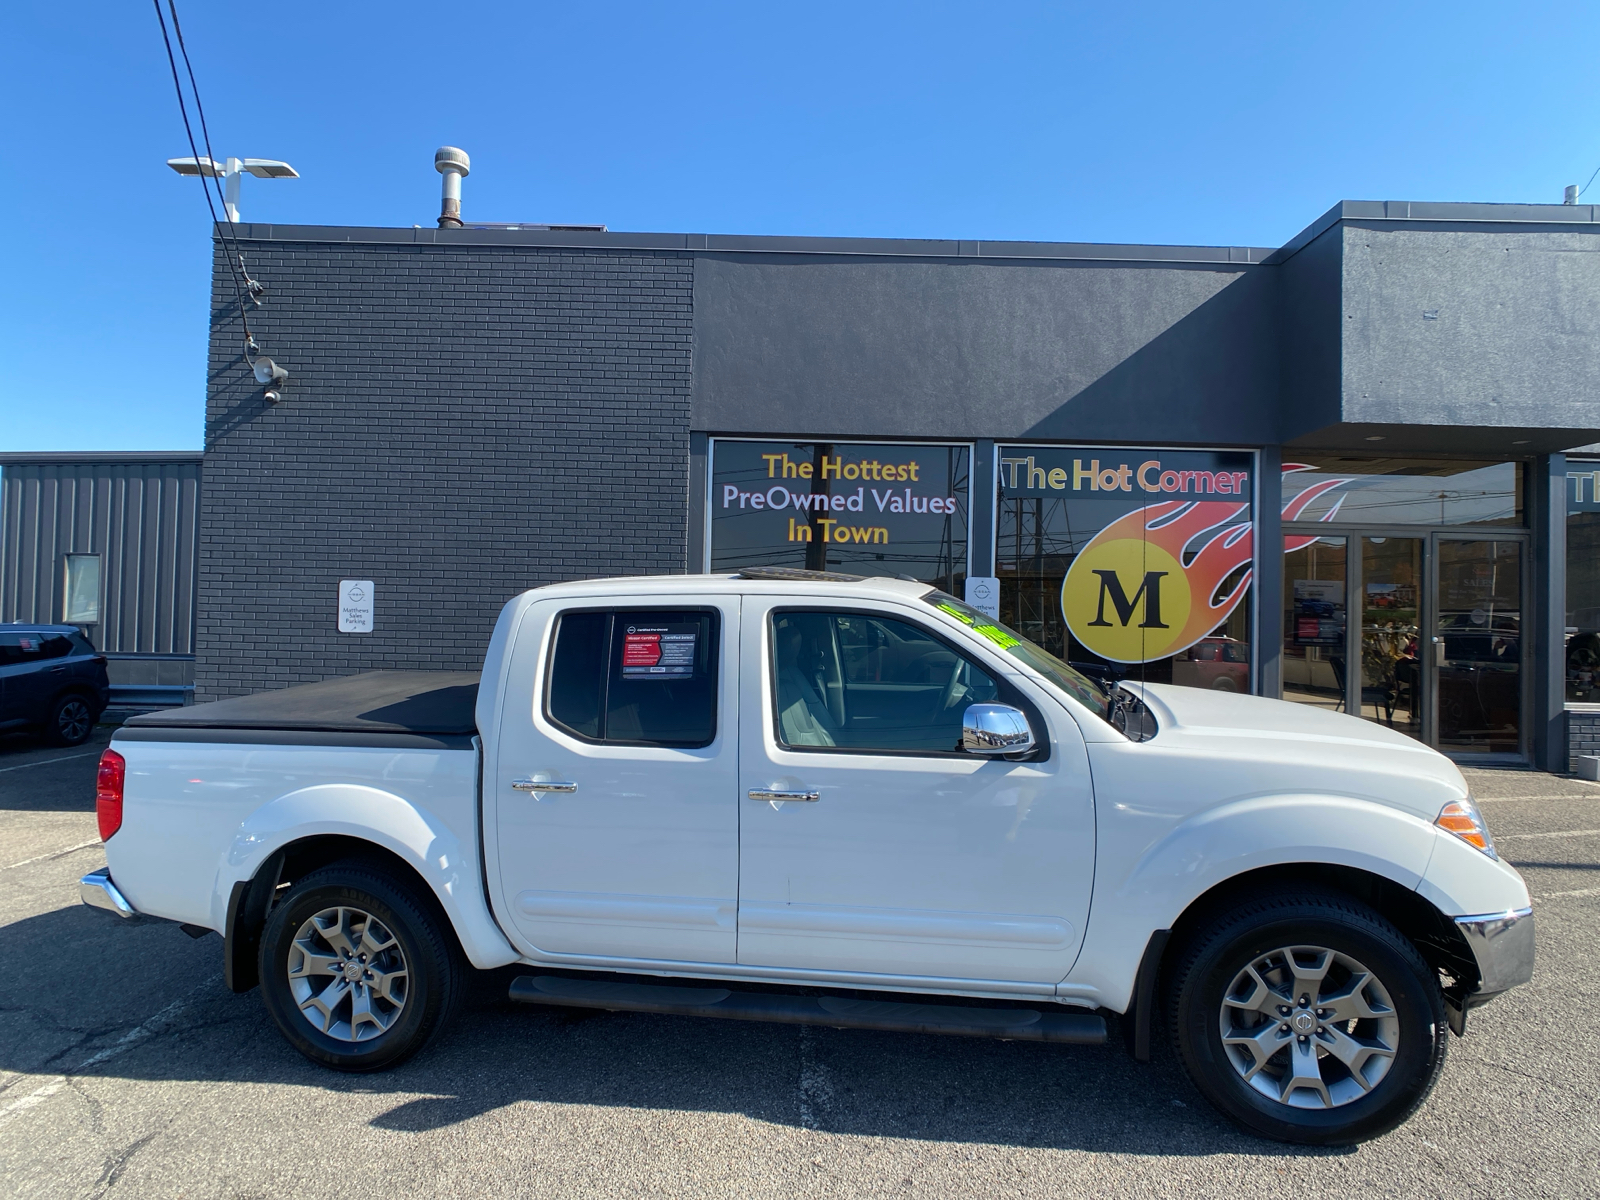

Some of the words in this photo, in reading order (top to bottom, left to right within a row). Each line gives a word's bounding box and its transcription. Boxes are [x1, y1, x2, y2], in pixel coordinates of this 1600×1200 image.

[762, 453, 814, 480] The
[821, 455, 919, 482] Hottest
[1001, 456, 1067, 489] The
[1073, 459, 1132, 492] Hot
[1137, 460, 1248, 494] Corner
[723, 485, 864, 512] PreOwned
[871, 488, 956, 515] Values
[788, 517, 812, 543] In
[817, 518, 889, 544] Town
[1087, 569, 1170, 629] M
